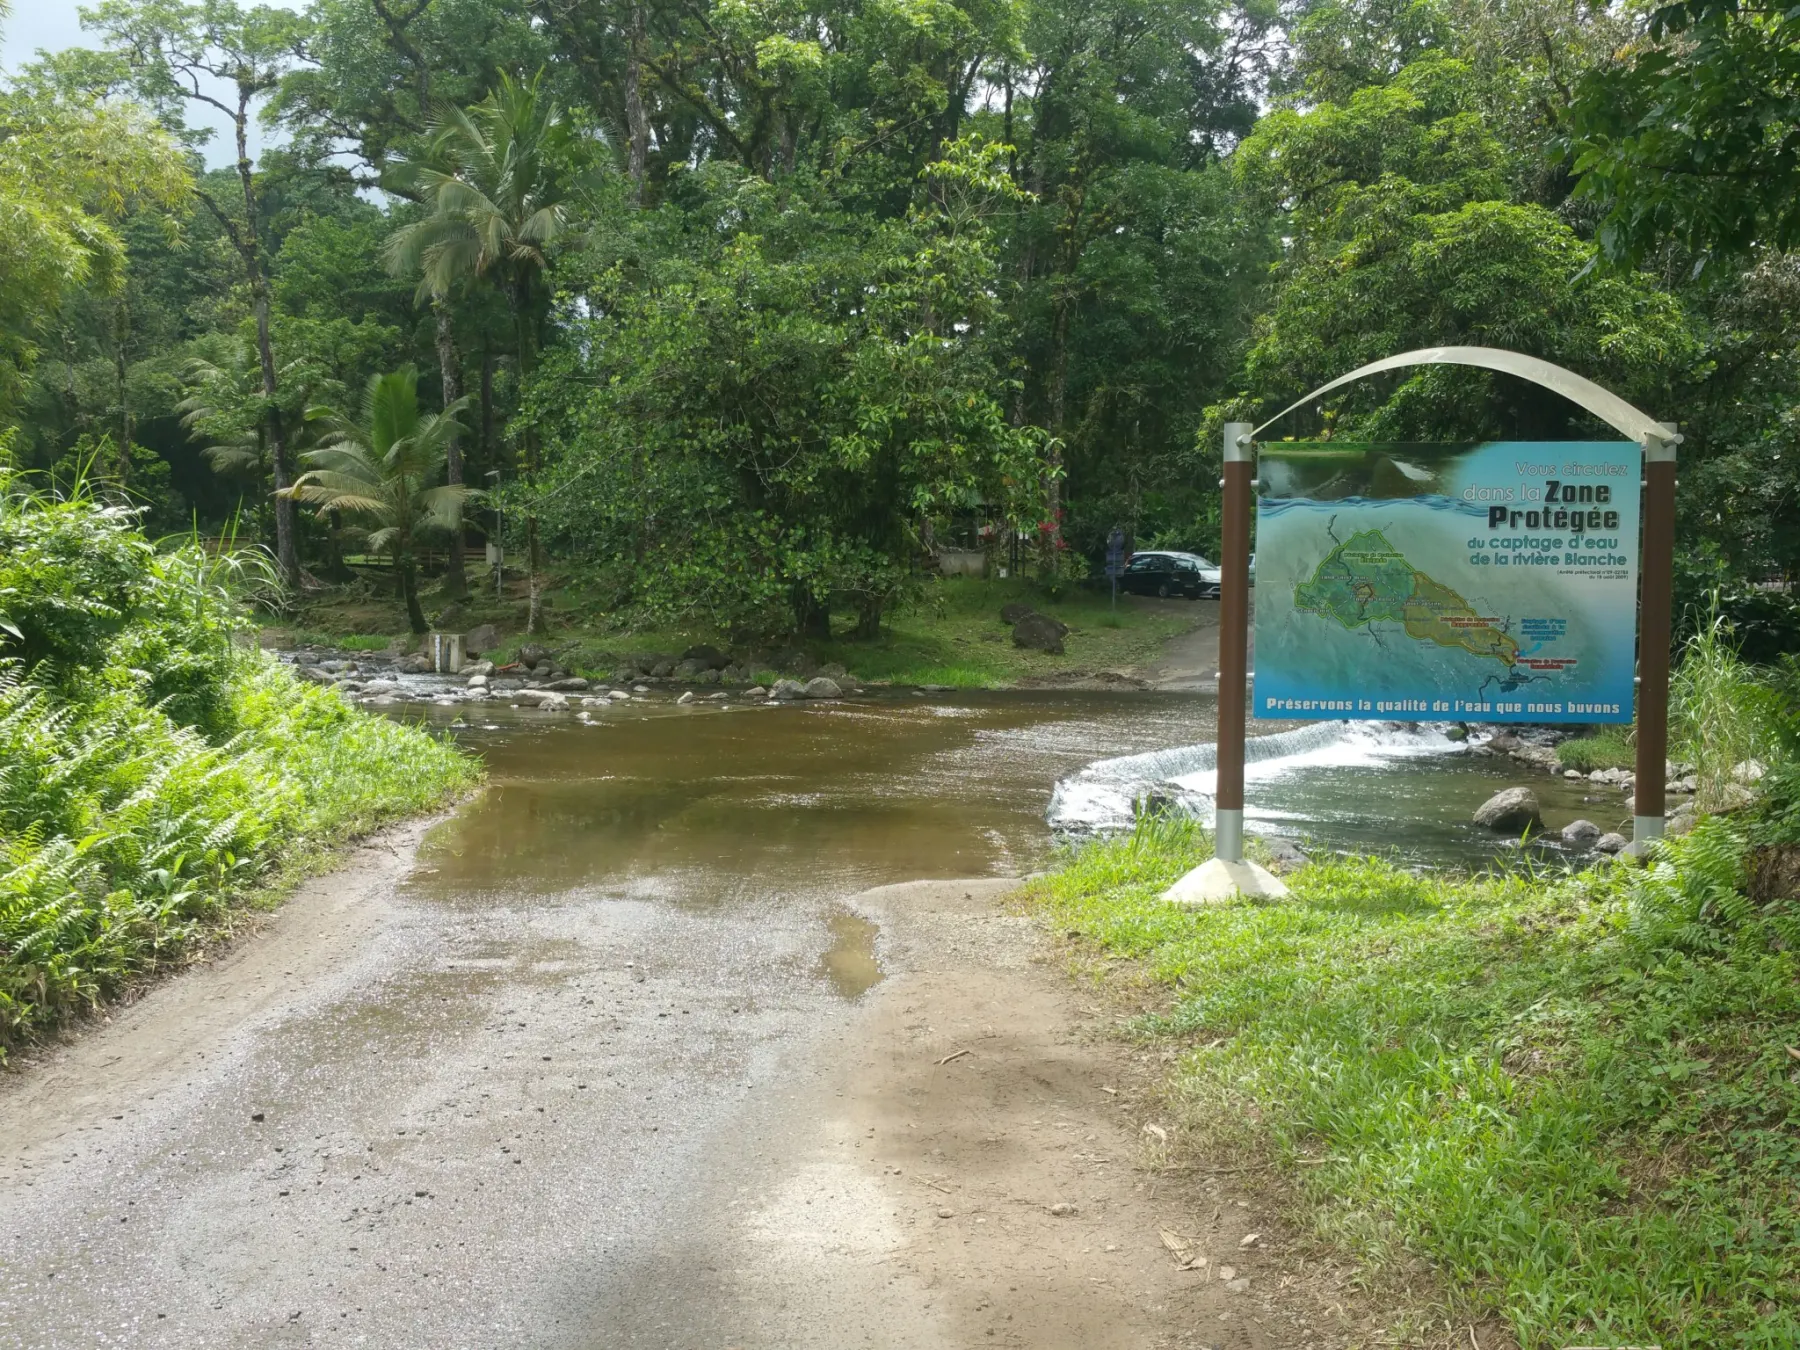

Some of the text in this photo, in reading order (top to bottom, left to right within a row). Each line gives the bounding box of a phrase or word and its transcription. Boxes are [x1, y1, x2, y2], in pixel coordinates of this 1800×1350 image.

[1515, 462, 1628, 476] Vous circulez
[1463, 480, 1610, 503] dans la Zone
[1488, 506, 1619, 533] Protégée
[1467, 535, 1618, 552] du captage d'eau
[1469, 551, 1627, 566] de la rivière Blanche
[1266, 698, 1353, 711] Préservons
[1358, 699, 1371, 711] la
[1376, 700, 1427, 713] qualité
[1432, 700, 1449, 712] de
[1496, 702, 1522, 714] que
[1527, 702, 1562, 713] nous
[1567, 701, 1620, 714] buvons
